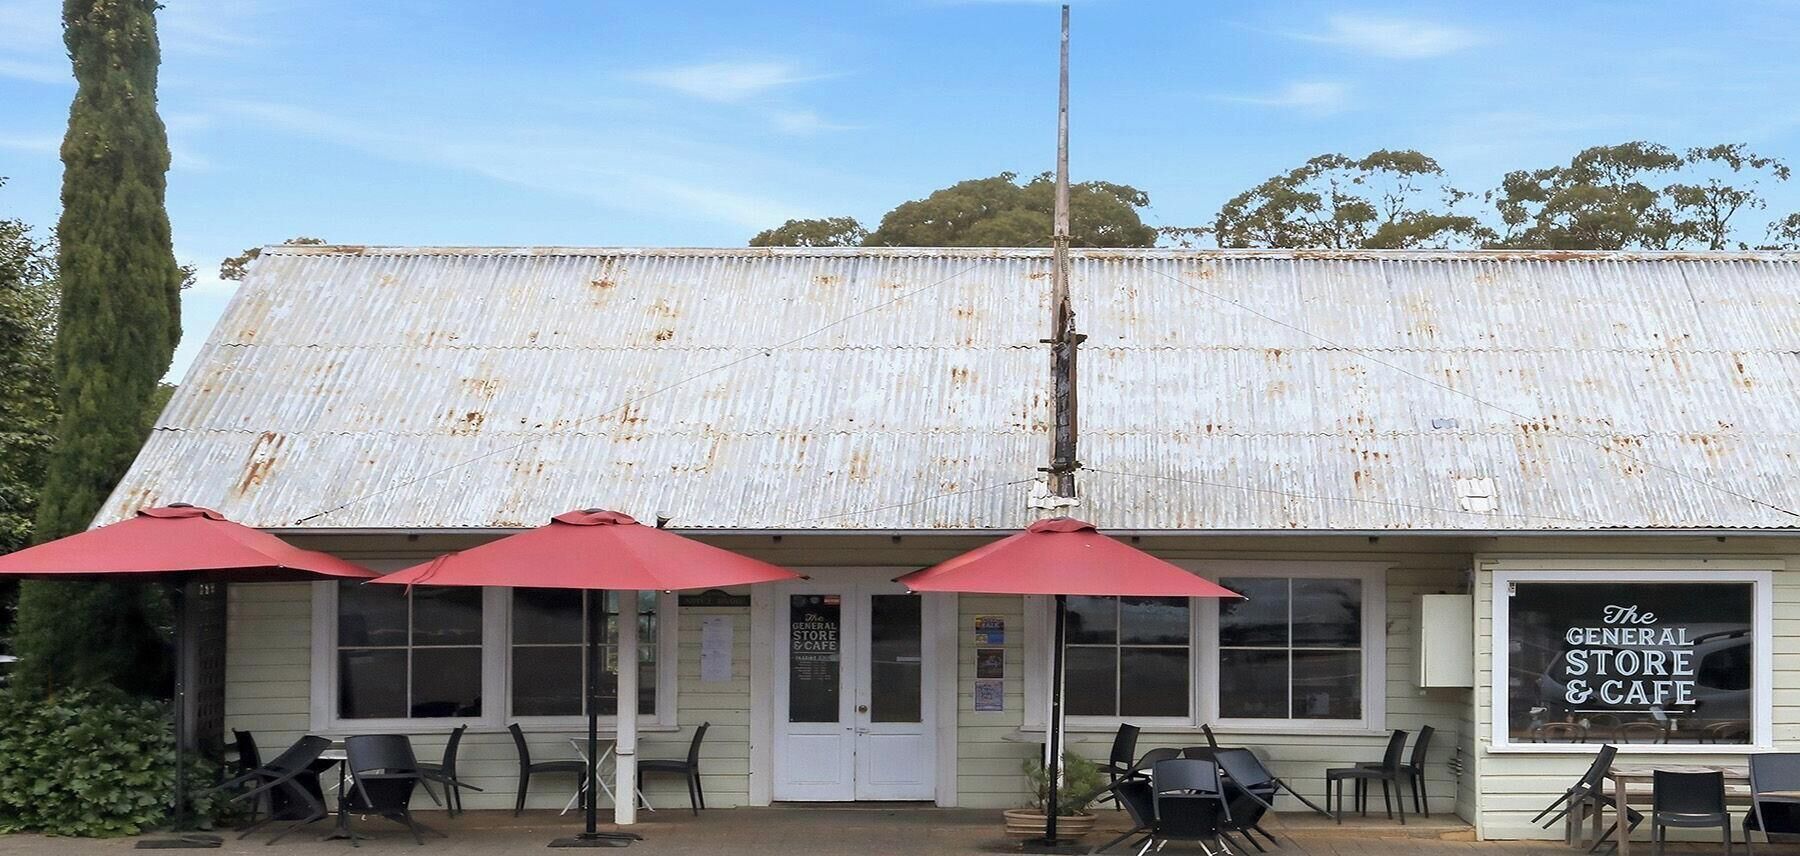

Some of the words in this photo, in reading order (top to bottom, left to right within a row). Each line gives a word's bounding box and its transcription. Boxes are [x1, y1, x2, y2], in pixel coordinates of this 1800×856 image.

[1603, 604, 1658, 624] The
[792, 622, 837, 630] GENERAL
[792, 630, 836, 640] STORE
[793, 641, 804, 650] &
[804, 641, 837, 650] CAFE
[1565, 627, 1695, 646] GENERAL
[1565, 649, 1694, 676] STORE
[1565, 679, 1593, 704] &
[1600, 679, 1697, 705] CAFE
